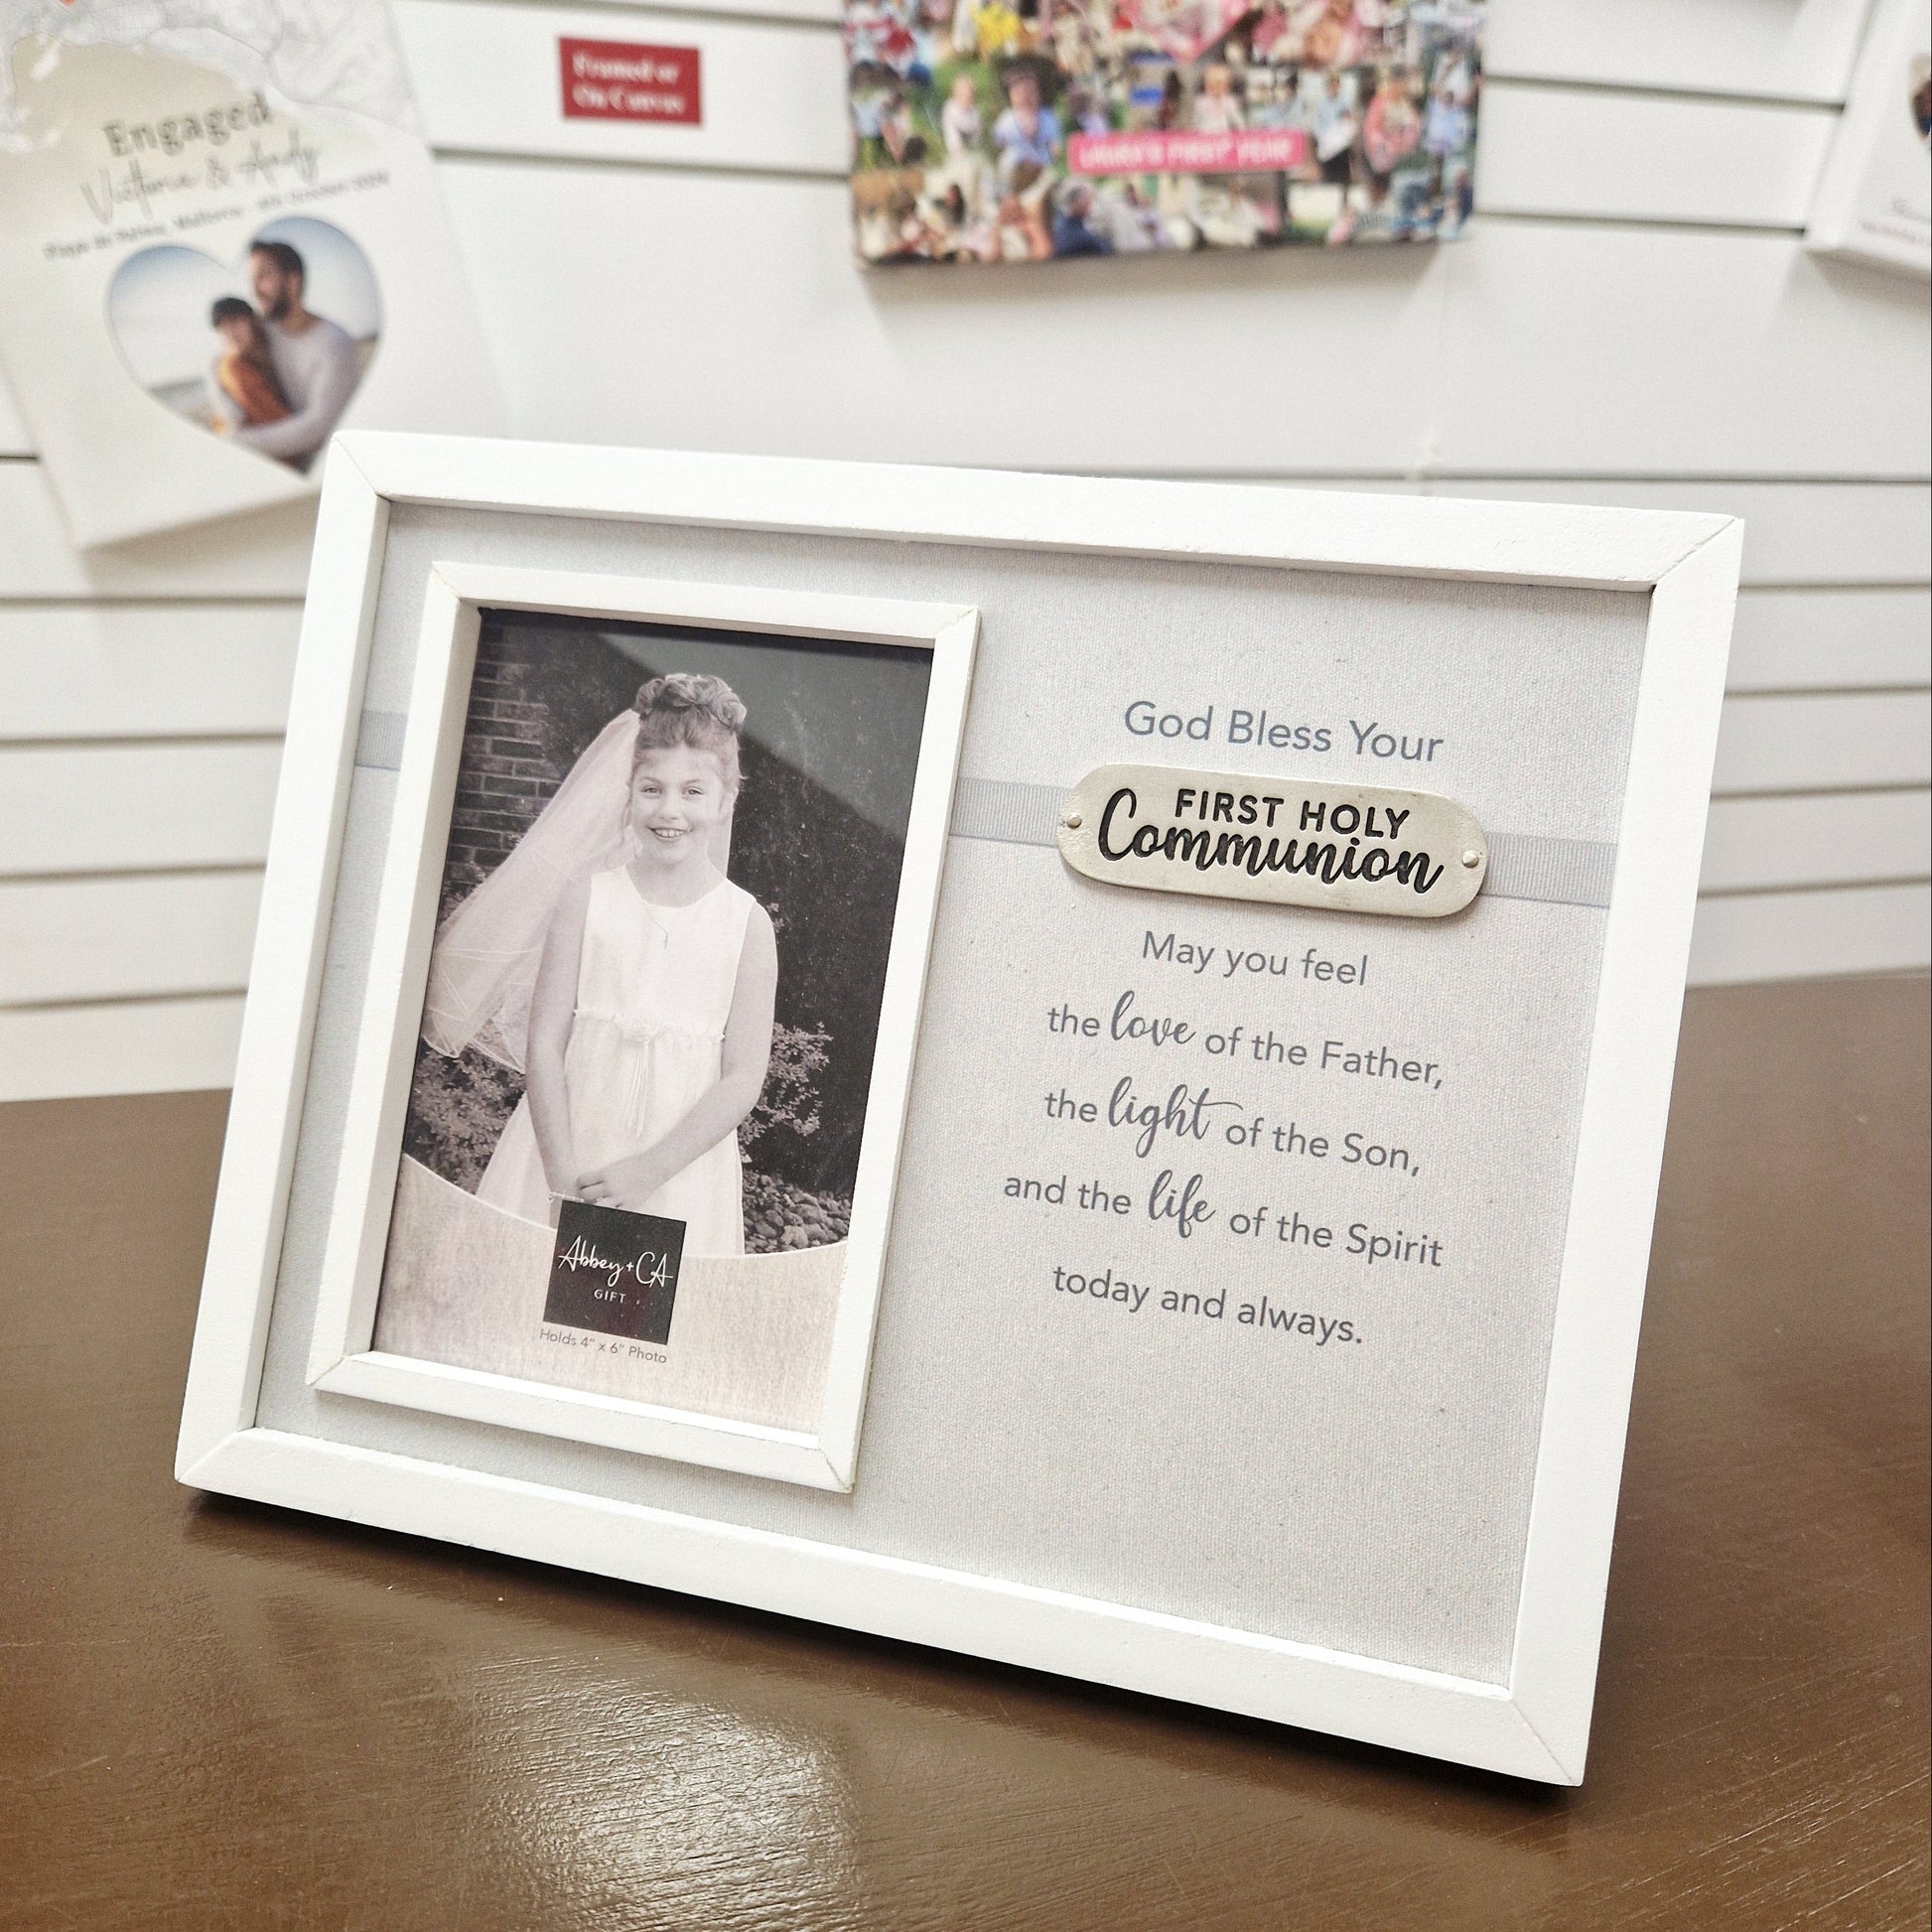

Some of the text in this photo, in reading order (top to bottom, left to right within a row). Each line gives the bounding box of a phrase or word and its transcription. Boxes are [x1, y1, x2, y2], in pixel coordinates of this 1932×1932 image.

[102, 87, 272, 158] Engaged
[1124, 701, 1444, 761] God Bless Your
[1097, 786, 1445, 894] Communion
[1173, 788, 1411, 841] FIRST HOLY
[1142, 930, 1368, 986] May you feel
[1047, 990, 1444, 1089] the love of the Father,
[1044, 1075, 1420, 1176] the light of the Son,
[1004, 1169, 1444, 1268] and the life of the Spirit
[557, 1234, 624, 1288] Abbey
[594, 1289, 626, 1305] GIFT
[1052, 1266, 1363, 1347] today and always.
[539, 1327, 577, 1347] Holds
[598, 1343, 607, 1353] x
[627, 1345, 667, 1365] Photo
